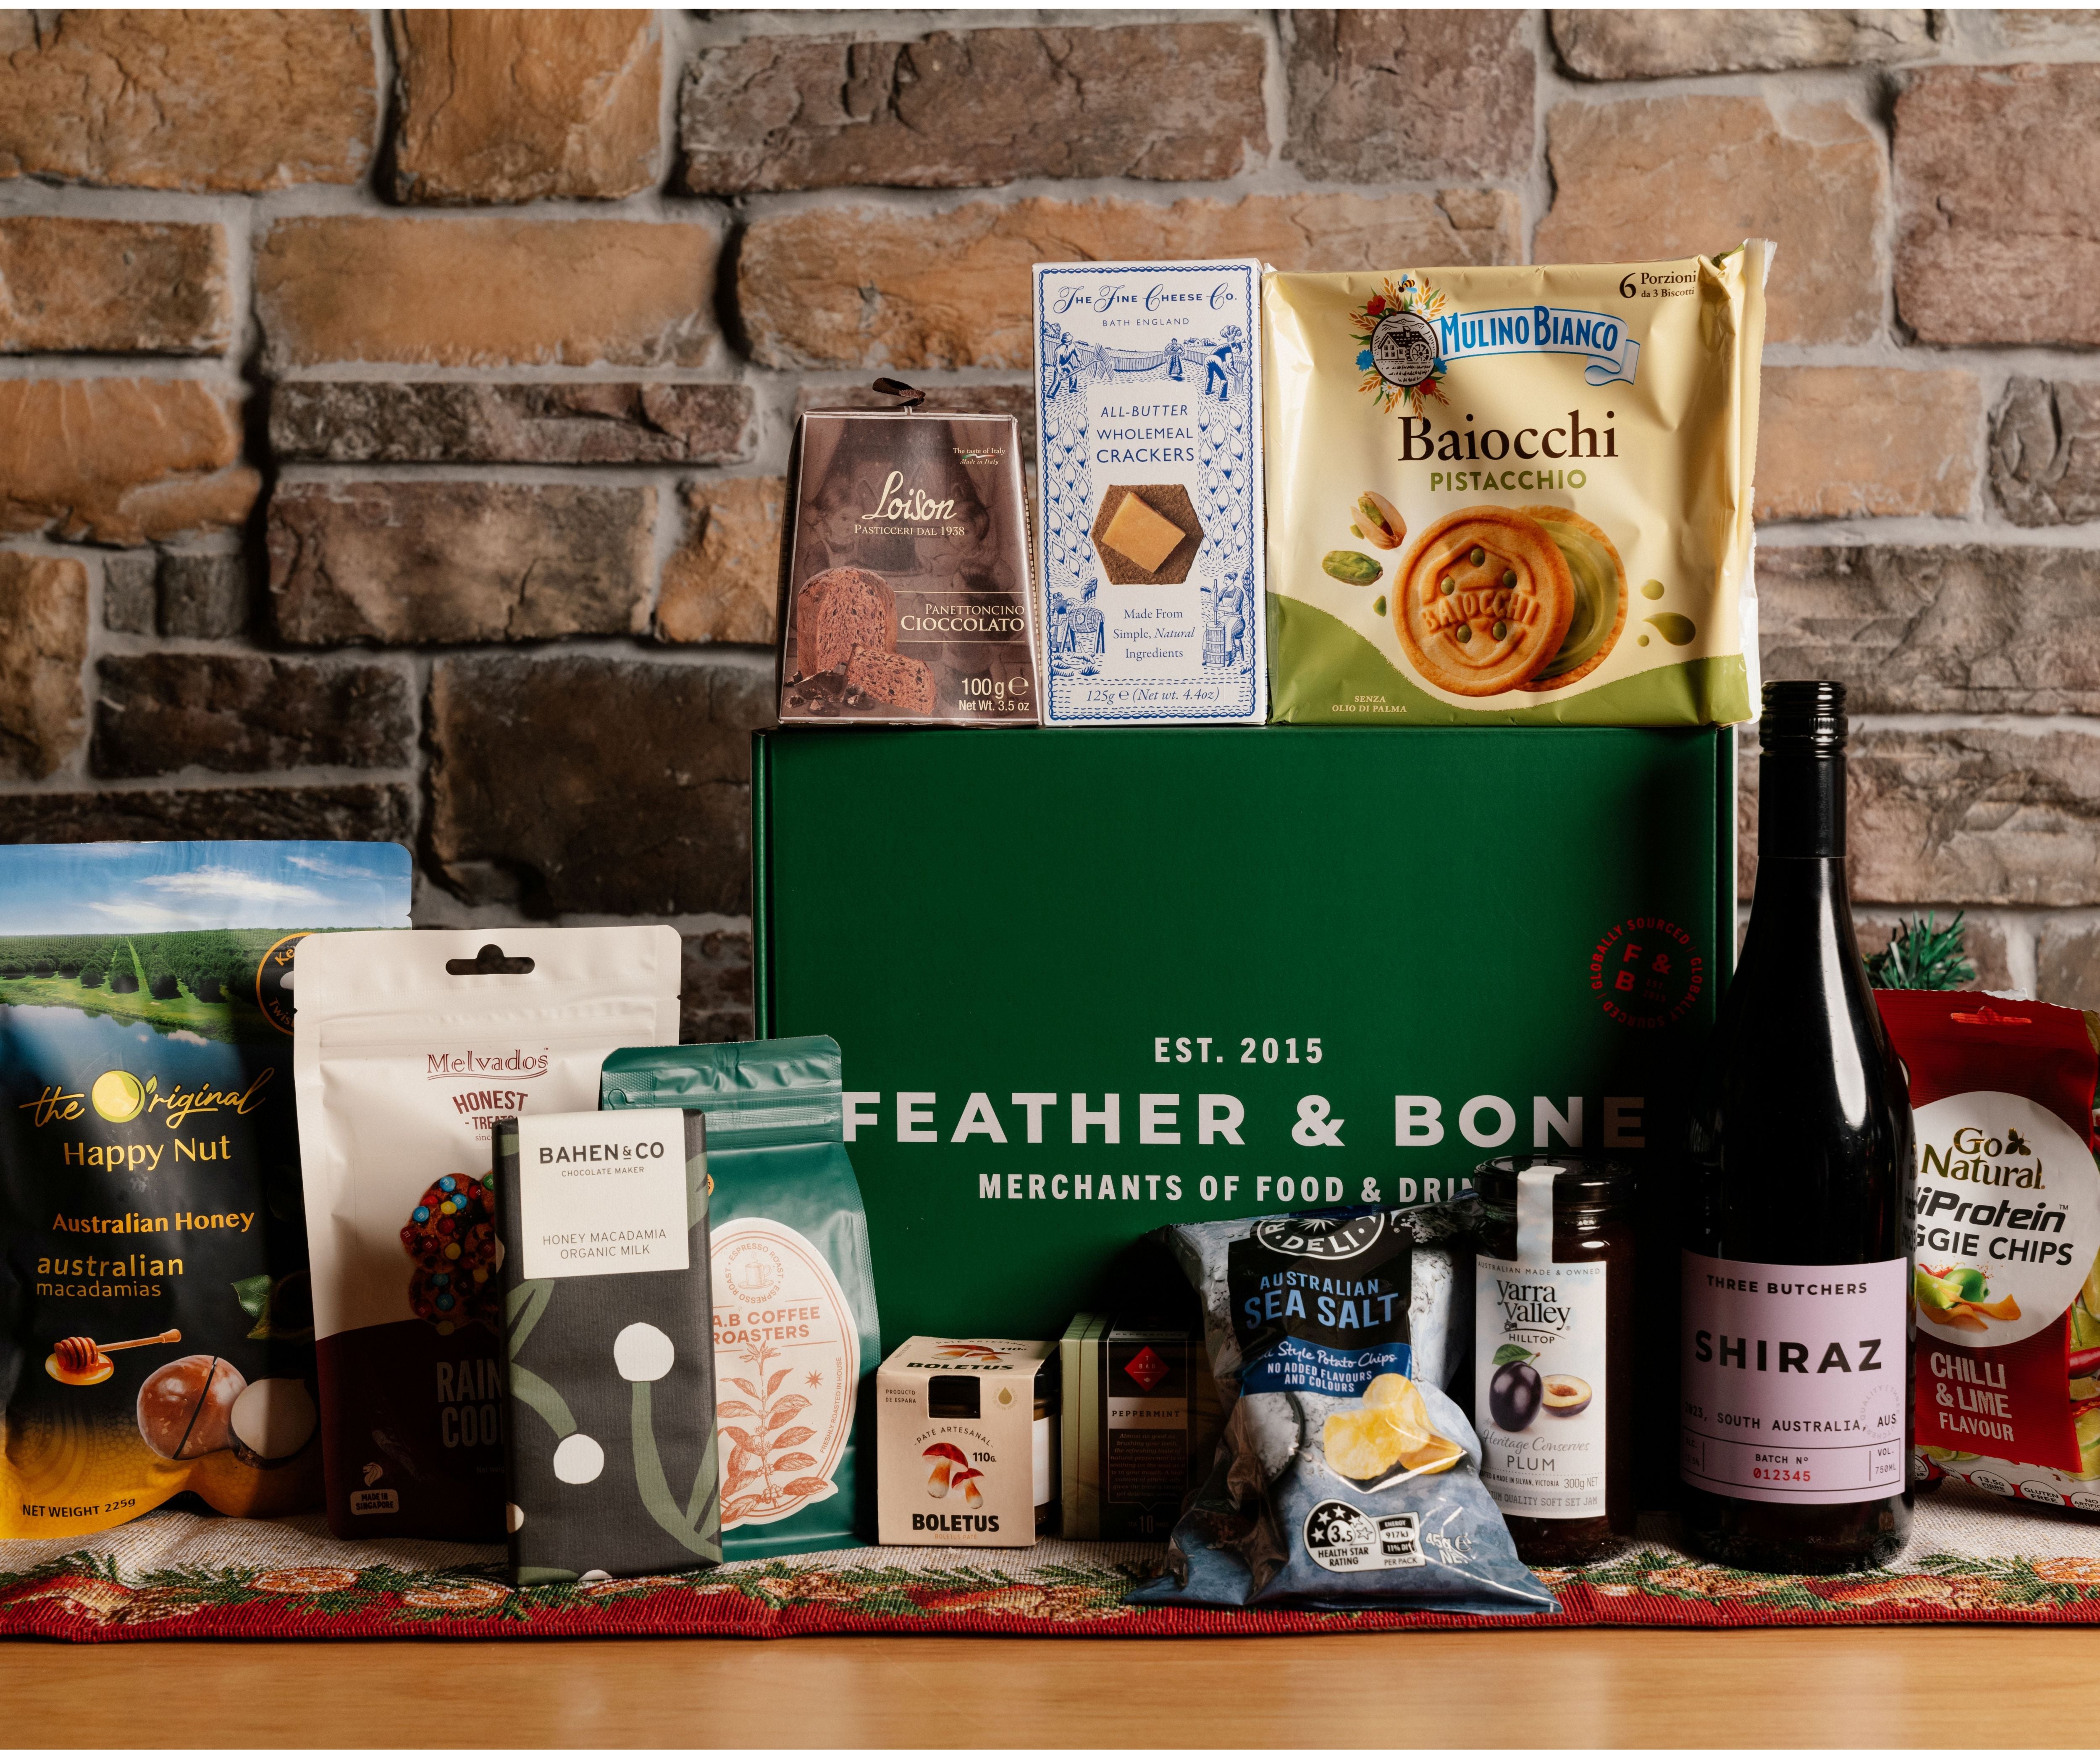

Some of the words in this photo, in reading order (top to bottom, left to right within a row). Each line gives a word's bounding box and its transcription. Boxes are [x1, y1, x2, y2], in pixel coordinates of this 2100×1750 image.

[1619, 272, 1637, 299] 6
[1641, 270, 1697, 286] Porzioni
[1641, 289, 1651, 299] da
[1653, 290, 1659, 299] 3
[1661, 286, 1695, 297] Biscotti
[1441, 314, 1529, 355] MULINO
[1535, 305, 1618, 352] BIANCO
[1101, 405, 1188, 418] ALL-BUTTER
[1097, 428, 1193, 440] WHOLEMEAL
[1398, 409, 1618, 461] Baiocchi
[991, 447, 1005, 456] Italy
[1097, 447, 1194, 463] CRACKERS
[1430, 469, 1587, 491] PISTACCHIO
[861, 471, 957, 520] Loison
[940, 526, 965, 536] 1938
[925, 604, 1025, 615] PANETTONCINO
[1124, 610, 1154, 619] Made
[1155, 609, 1183, 619] From
[1421, 592, 1539, 633] BAIOCCHI
[901, 615, 1025, 632] CIOCCOLATO
[1113, 628, 1151, 641] Simple,
[1153, 627, 1195, 639] Natural
[1125, 648, 1183, 662] Ingredients
[1086, 689, 1116, 704] 125g
[1133, 688, 1160, 702] (Net
[1162, 690, 1179, 701] wt.
[1183, 687, 1220, 702] 4.4oz)
[959, 701, 976, 711] Net
[978, 701, 996, 711] Wt.
[998, 701, 1014, 711] 3.5
[1016, 703, 1029, 711] oz
[1590, 925, 1623, 990] GLOBALLY
[1626, 917, 1690, 945] SOURCED
[1155, 1037, 1223, 1063] EST.
[1240, 1037, 1323, 1064] 2015
[19, 1086, 85, 1127] the
[452, 1090, 528, 1115] HONEST
[843, 1091, 1246, 1146] FEATHER
[1291, 1094, 1345, 1146] &
[1395, 1094, 1646, 1148] BONE
[1953, 1127, 2003, 1157] Go
[64, 1142, 164, 1172] Happy
[175, 1135, 231, 1162] Nut
[562, 1168, 612, 1177] CHOCOLATE
[1919, 1143, 2043, 1190] Natural
[979, 1173, 1183, 1201] MERCHANTS
[1200, 1175, 1240, 1201] OF
[1257, 1175, 1344, 1202] FOOD
[1361, 1176, 1381, 1203] &
[52, 1213, 168, 1233] Australian
[175, 1212, 255, 1232] Honey
[543, 1233, 586, 1245] HONEY
[590, 1229, 667, 1243] MACADAMIA
[1281, 1231, 1360, 1254] DELI
[560, 1246, 616, 1259] ORGANIC
[621, 1245, 650, 1256] MILK
[1988, 1236, 2074, 1266] CHIPS
[37, 1254, 184, 1277] australian
[728, 1243, 769, 1261] ESPRESSO
[769, 1250, 785, 1279] ROAST
[1478, 1261, 1520, 1274] AUSTRALIAN
[37, 1280, 161, 1297] macadamias
[1260, 1271, 1379, 1297] AUSTRALIAN
[1707, 1274, 1759, 1293] THREE
[1767, 1282, 1867, 1295] BUTCHERS
[747, 1306, 820, 1325] COFFEE
[1244, 1290, 1306, 1330] SEA
[1317, 1293, 1399, 1330] SALT
[1503, 1301, 1571, 1331] Valley
[1509, 1333, 1555, 1344] HILLTOP
[1277, 1342, 1314, 1363] Style
[1317, 1350, 1357, 1368] Potato
[1357, 1352, 1398, 1368] Chips
[1695, 1330, 1882, 1374] SHIRAZ
[906, 1362, 1014, 1371] BOLETUS
[1267, 1363, 1281, 1374] NO
[1284, 1362, 1318, 1377] ADDED
[1320, 1369, 1372, 1382] FLAVOURS
[1930, 1352, 2006, 1389] CHILLI
[1284, 1374, 1305, 1385] AND
[1309, 1377, 1354, 1393] COLOURS
[1936, 1382, 1955, 1408] &
[1956, 1386, 2012, 1419] LIME
[820, 1423, 836, 1454] FRESHLY
[831, 1390, 843, 1423] ROASTED
[1717, 1413, 1760, 1429] SOUTH
[1772, 1419, 1866, 1432] AUSTRALIA,
[1877, 1413, 1896, 1428] AUS
[1939, 1412, 2014, 1442] FLAVOUR
[1483, 1429, 1530, 1455] Heritage
[1532, 1437, 1591, 1452] Conserves
[1755, 1454, 1788, 1464] BATCH
[1877, 1448, 1895, 1457] VOL.
[1507, 1455, 1555, 1471] PLUM
[1874, 1463, 1896, 1474] 750ML
[1564, 1478, 1585, 1490] 300g
[1587, 1477, 1599, 1487] NET
[1753, 1468, 1811, 1482] 012345
[1504, 1493, 1538, 1506] QUALITY
[1541, 1498, 1562, 1507] SOFT
[1565, 1498, 1580, 1506] SET
[1583, 1496, 1597, 1506] JAM
[2024, 1487, 2059, 1499] GLUTEN
[2030, 1493, 2058, 1503] FREE
[23, 1504, 46, 1517] NET
[48, 1505, 100, 1518] WEIGHT
[104, 1497, 136, 1514] 225g
[355, 1500, 394, 1511] SINGAPORE
[912, 1513, 1000, 1533] BOLETUS
[1331, 1525, 1353, 1542] 3.5
[1318, 1548, 1347, 1558] HEALTH
[1349, 1547, 1368, 1556] STAR
[1329, 1557, 1359, 1567] RATING
